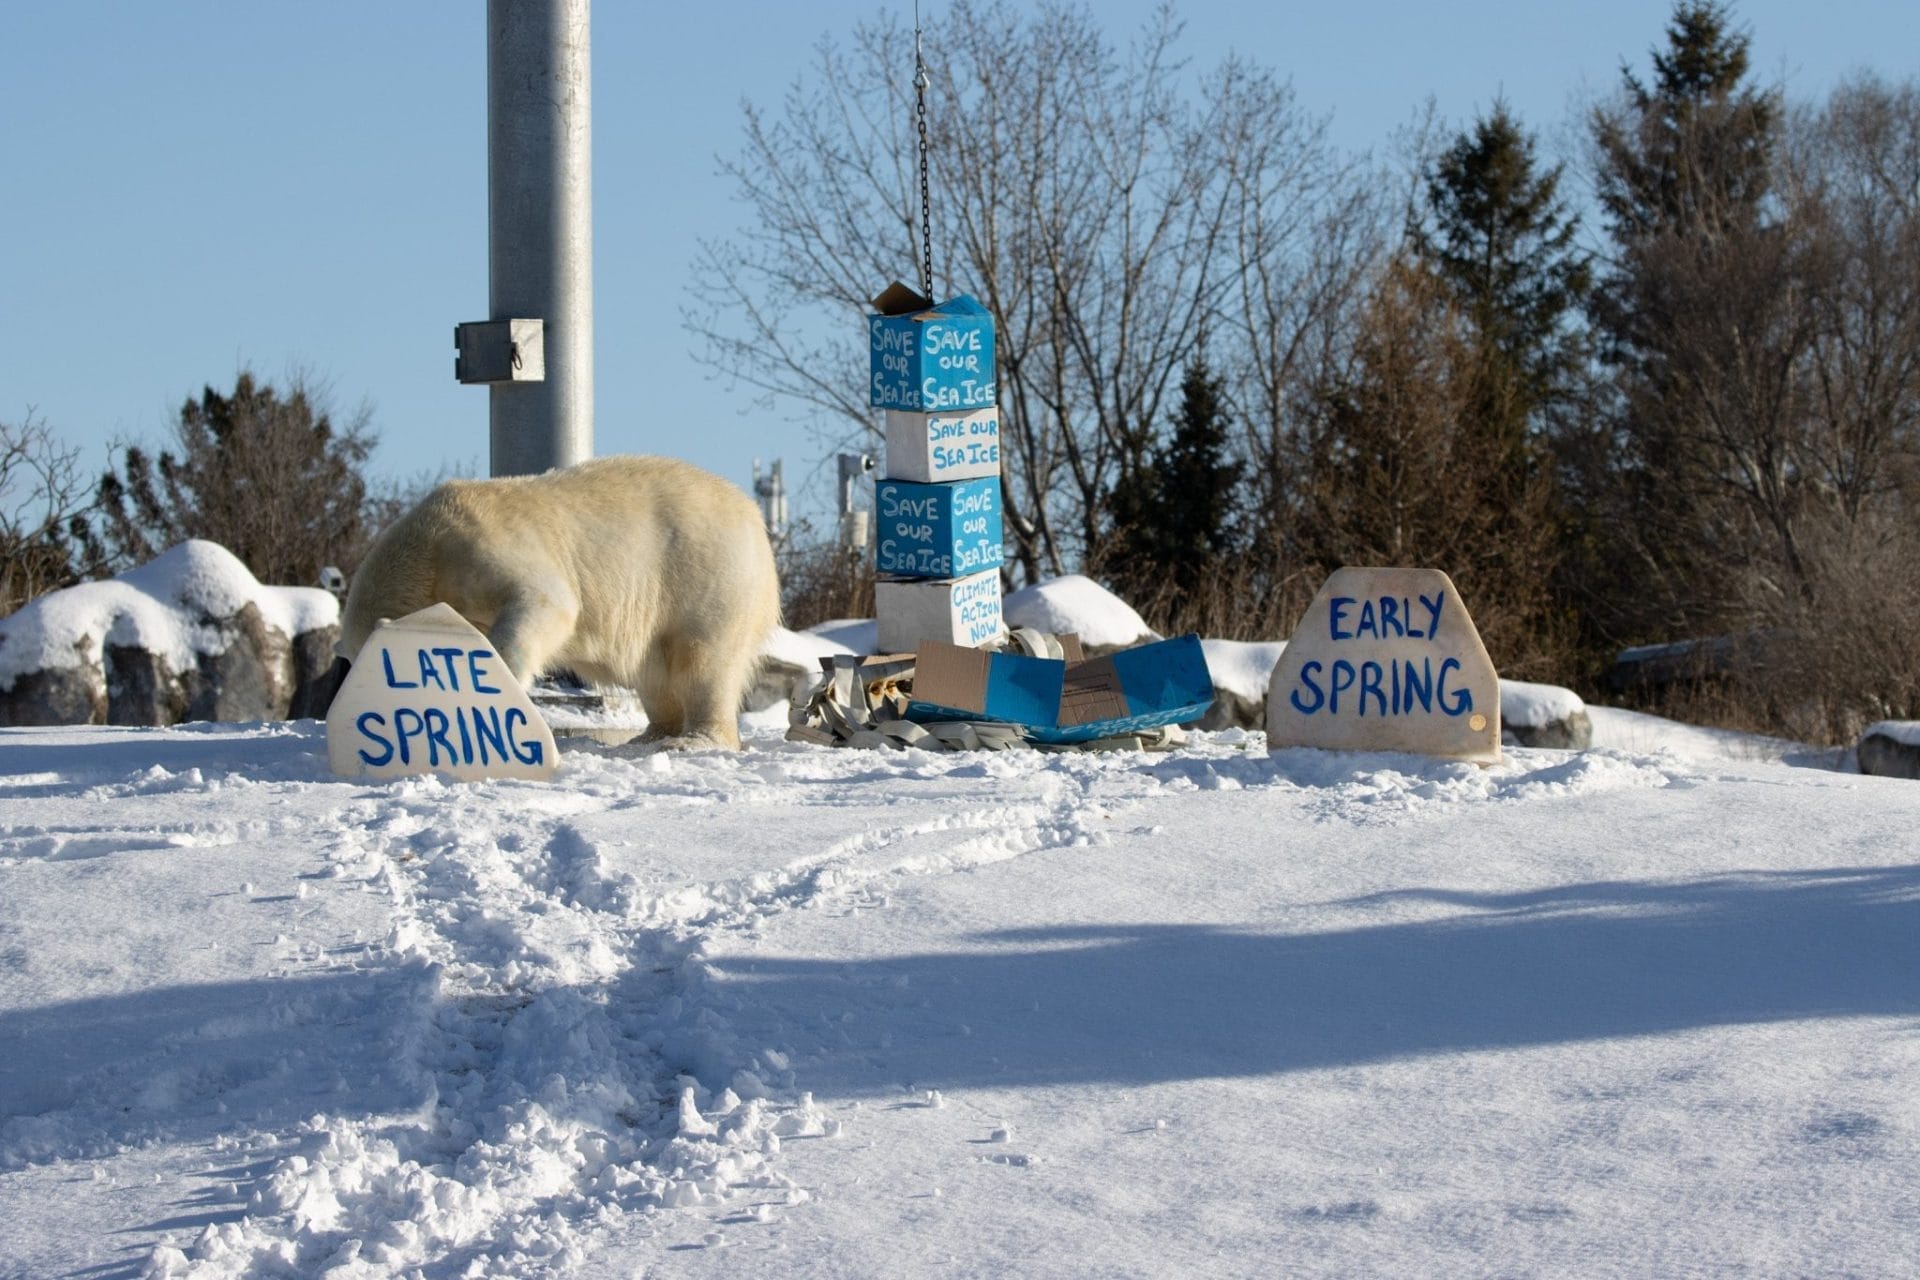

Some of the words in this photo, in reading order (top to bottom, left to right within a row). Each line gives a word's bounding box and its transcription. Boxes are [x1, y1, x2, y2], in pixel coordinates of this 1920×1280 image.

[872, 319, 914, 357] SAVE
[925, 325, 982, 354] SAVE
[882, 353, 910, 377] OUR
[939, 354, 979, 373] OUR
[872, 371, 898, 405] SEA
[898, 380, 920, 408] ICE
[922, 377, 960, 409] SEA
[960, 379, 996, 405] ICE
[929, 417, 965, 441] SAVE
[969, 420, 997, 436] OUR
[933, 446, 965, 469] SEA
[967, 443, 998, 464] ICE
[880, 486, 939, 520] SAVE
[953, 487, 993, 516] SAVE
[895, 522, 933, 544] OUR
[963, 517, 988, 534] OUR
[881, 539, 916, 570] SEA
[917, 548, 951, 574] ICE
[953, 539, 977, 571] SEA
[977, 539, 1003, 564] ICE
[953, 575, 997, 607] CLIMATE
[961, 600, 999, 624] ACTION
[1330, 590, 1444, 641] EARLY
[970, 619, 997, 644] NOW
[381, 648, 501, 694] LATE
[1290, 656, 1473, 717] SPRING
[356, 706, 543, 767] SPRING
